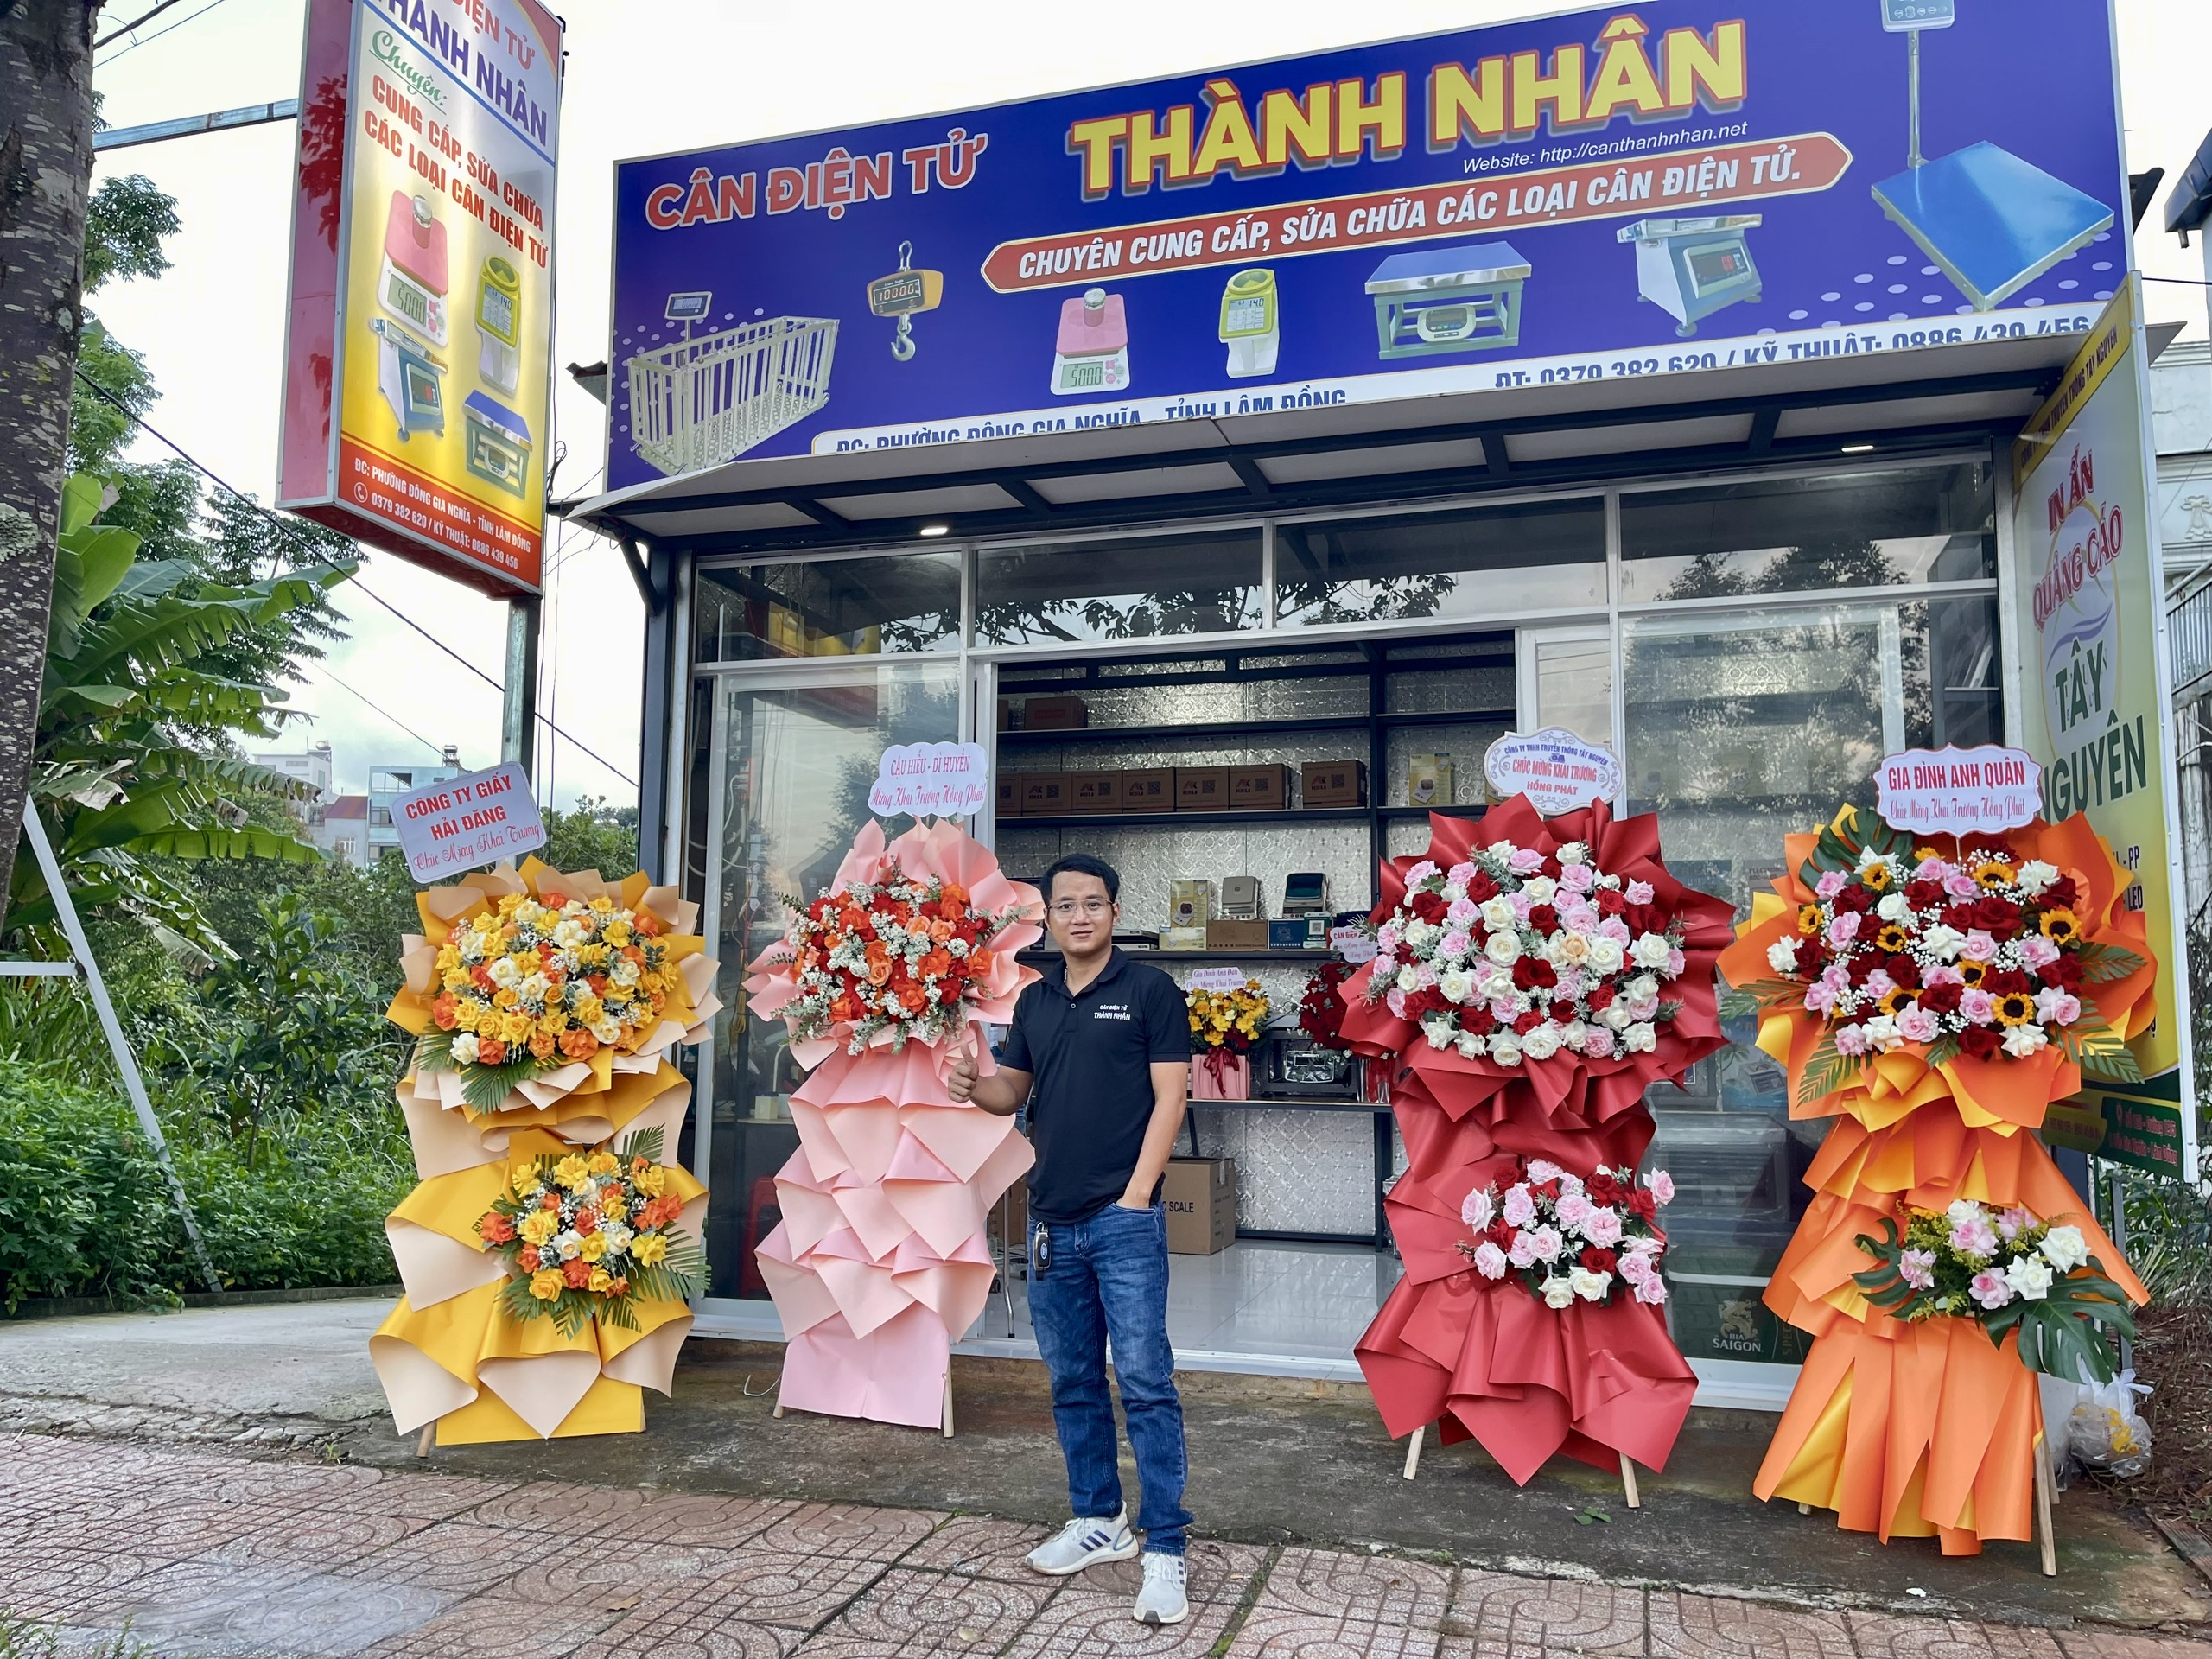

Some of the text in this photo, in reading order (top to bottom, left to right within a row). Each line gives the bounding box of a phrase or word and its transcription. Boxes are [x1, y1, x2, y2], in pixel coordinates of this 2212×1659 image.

[372, 30, 448, 106] Chuyên:
[505, 27, 536, 70] TỬ
[476, 51, 547, 147] NHÂN
[1069, 14, 1747, 200] THÀNH NHÂN
[372, 75, 423, 135] CUNG
[429, 124, 462, 168] CẤP,
[467, 151, 499, 197] SỬA
[1464, 121, 1748, 173] Website: http://canthanhnhan.net
[365, 110, 549, 269] CÁC LOẠI CÂN ĐIỆN TỬ
[646, 128, 988, 229] CÂN ĐIỆN TỬ
[1019, 143, 1801, 279] CHUYÊN CUNG CẤP, SỬA CHỮA CÁC LOẠI CÂN ĐIỆN TỬ.
[354, 457, 370, 477] ĐC:
[372, 466, 407, 495] PHƯỜNG
[409, 484, 431, 505] ĐÔNG
[433, 495, 446, 513] GIA
[448, 504, 471, 525] NGHĨA
[2048, 443, 2094, 536] IN ẤN
[372, 493, 393, 513] 0379
[395, 503, 410, 521] 382
[412, 512, 427, 530] 620
[472, 538, 490, 557] 0886
[491, 547, 504, 563] 439
[505, 554, 518, 570] 456
[2033, 550, 2084, 633] QUẢNG
[2087, 501, 2123, 579] CÁO
[2055, 638, 2103, 733] TÂY
[932, 751, 942, 773] DÌ
[1503, 745, 1519, 754] CÔNG
[1541, 742, 1560, 753] TRUYỀN
[1561, 746, 1578, 756] THÔNG
[1579, 748, 1588, 759] TÂY
[1588, 752, 1608, 766] NGUYÊN
[1512, 756, 1531, 774] CHÚC
[1532, 758, 1552, 777] MỪNG
[1554, 763, 1569, 779] KHAI
[1570, 765, 1597, 782] TRƯƠNG
[1888, 757, 2025, 791] GIA ĐÌNH ANH QUÂN
[2038, 709, 2147, 825] NGUYÊN
[405, 772, 512, 819] CÔNG TY GIẤY
[1527, 779, 1578, 796] HỒNG PHÁT
[1931, 798, 1949, 819] Khai
[1981, 795, 2003, 821] Hồng
[2005, 795, 2025, 820] Phát
[430, 805, 507, 841] HẢI ĐĂNG
[477, 831, 505, 853] Khai
[2128, 845, 2140, 871] PP
[2127, 885, 2143, 910] LED
[1169, 1201, 1194, 1213] SCALE
[1713, 1338, 1762, 1353] SAIGON
